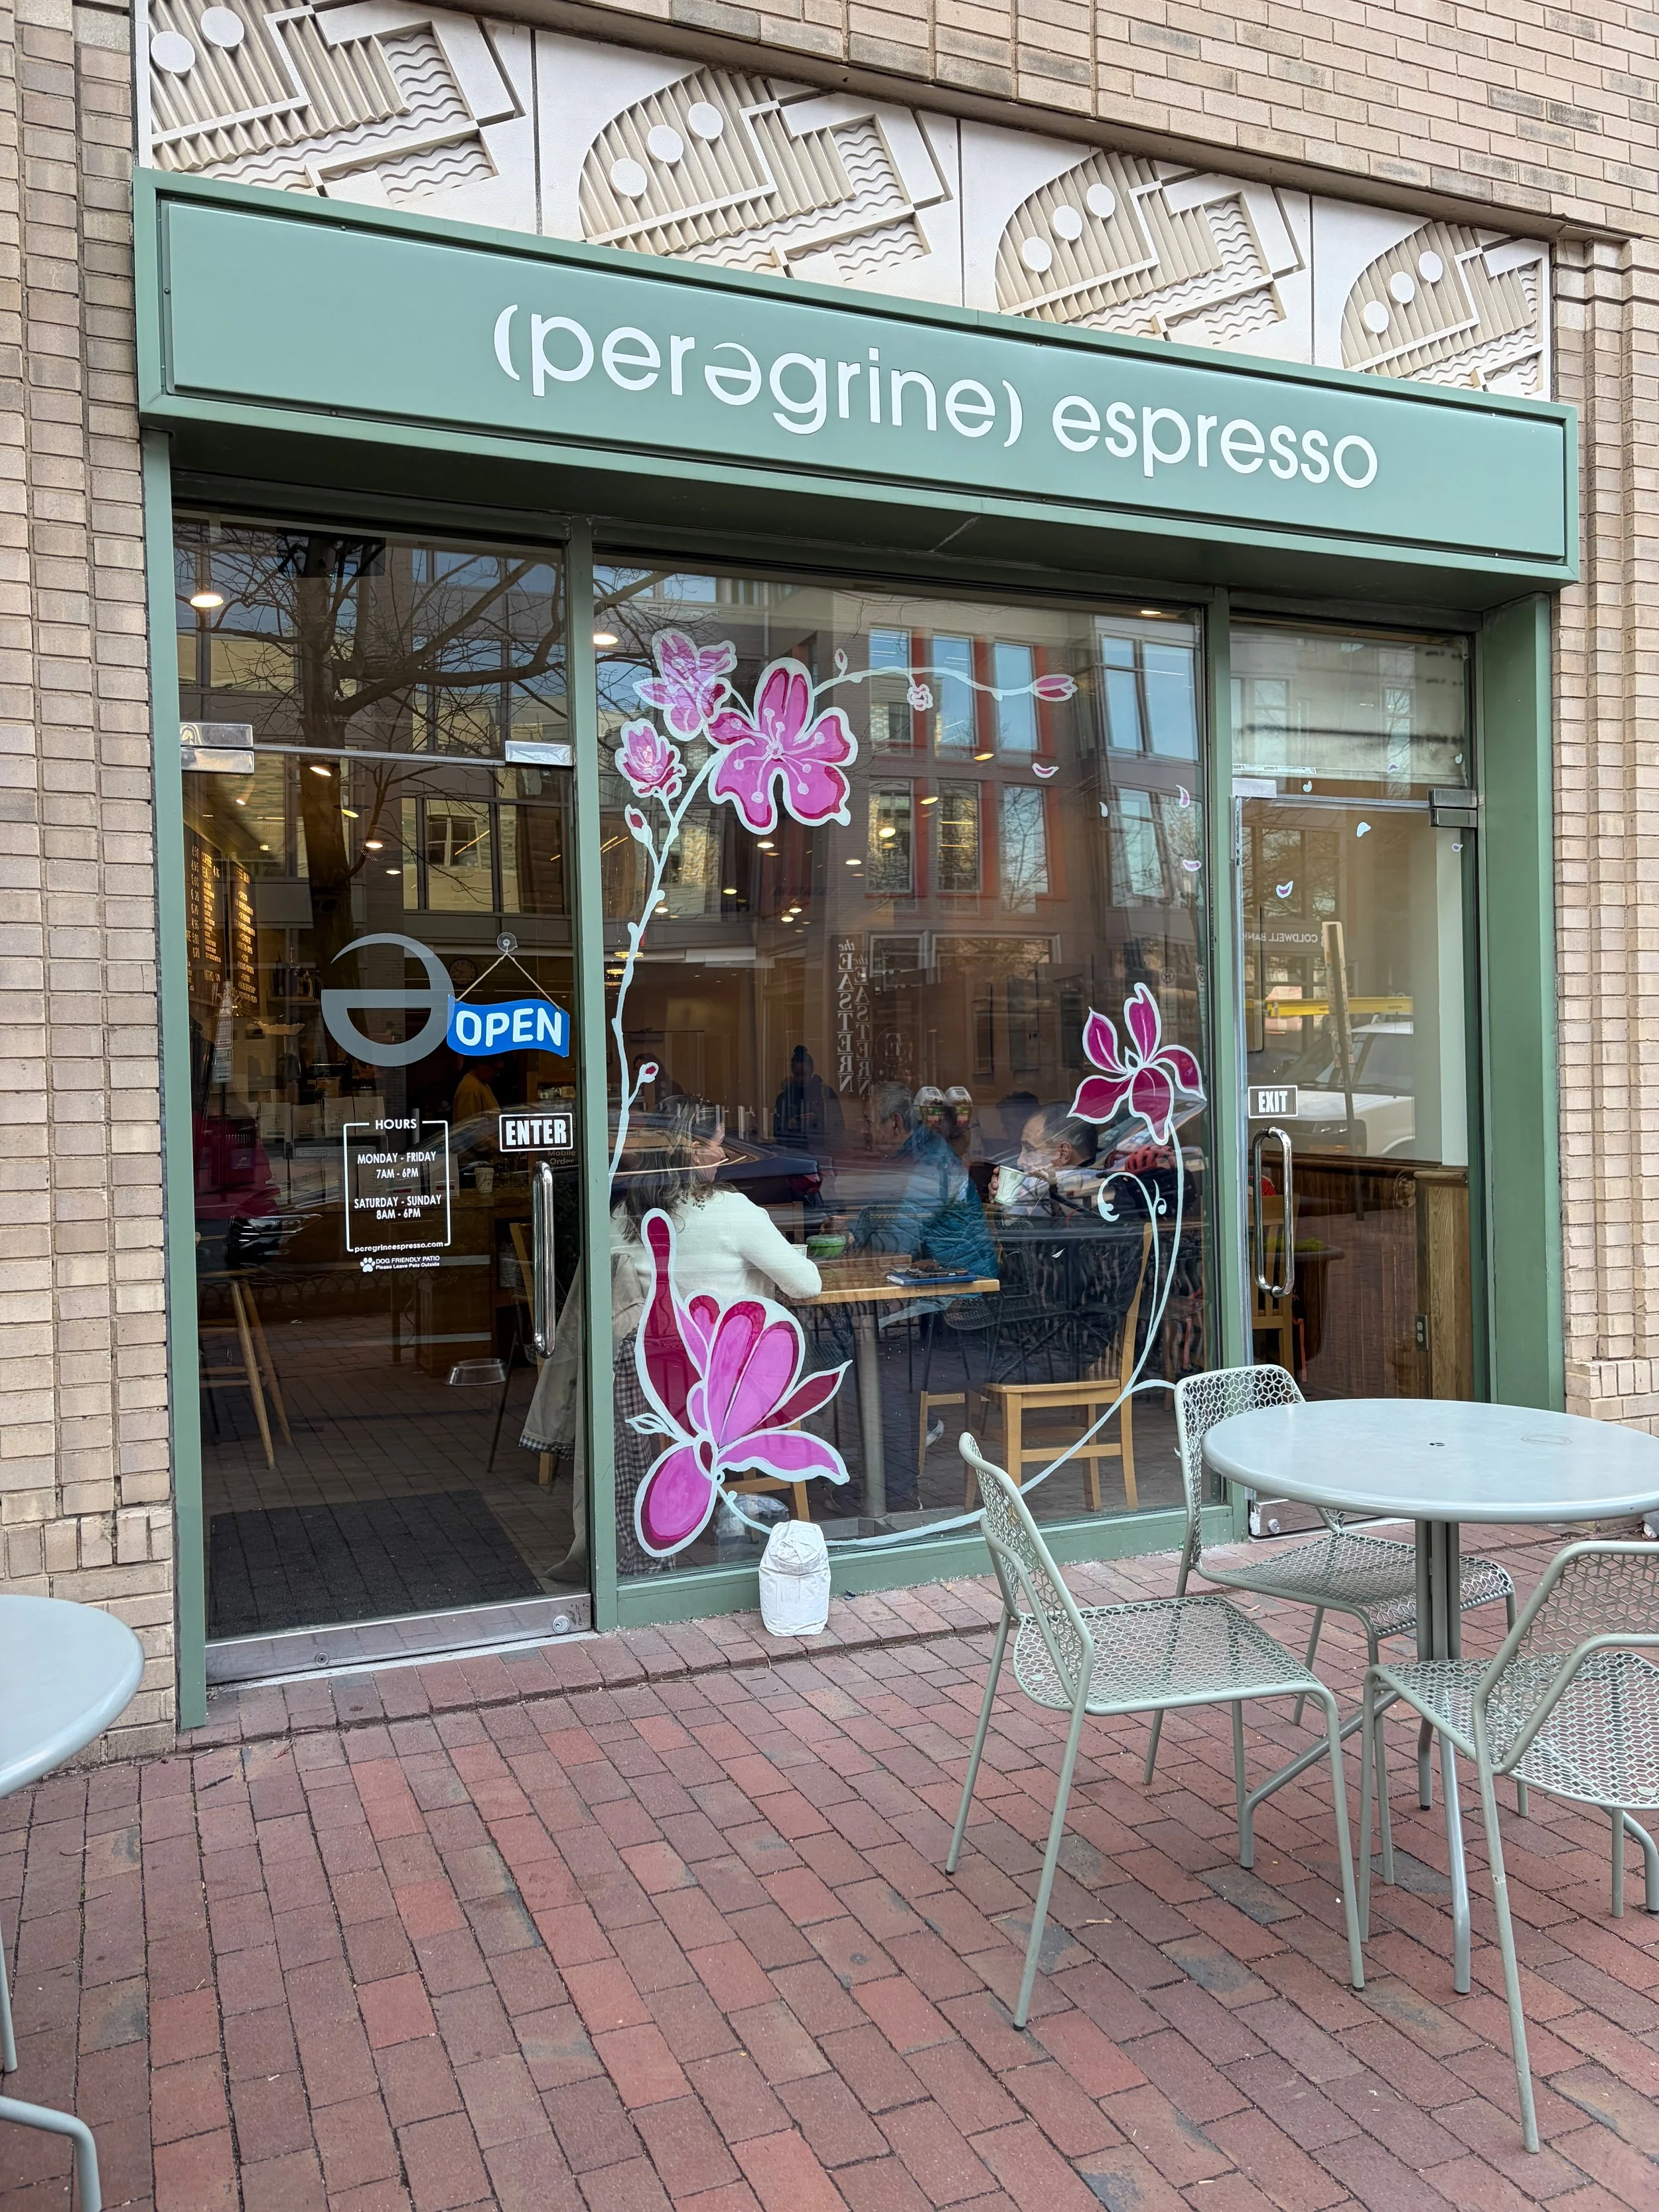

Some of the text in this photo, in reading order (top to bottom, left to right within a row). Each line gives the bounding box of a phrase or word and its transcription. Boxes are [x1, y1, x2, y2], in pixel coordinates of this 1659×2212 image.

[1052, 394, 1378, 489] espresso
[456, 1007, 562, 1047] OPEN
[1258, 1090, 1288, 1113] EXIT
[376, 1119, 417, 1130] HOURS
[506, 1120, 567, 1145] ENTER
[357, 1153, 398, 1165] MONDAY
[407, 1151, 437, 1162] FRIDAY
[376, 1169, 395, 1179] 7AM
[402, 1168, 419, 1178] 6PM
[354, 1197, 398, 1209] SATURDAY
[407, 1195, 442, 1207] SUNDAY
[376, 1209, 396, 1220] 8AM
[403, 1208, 421, 1218] 6PM
[354, 1242, 443, 1253] peregrineespresso.com
